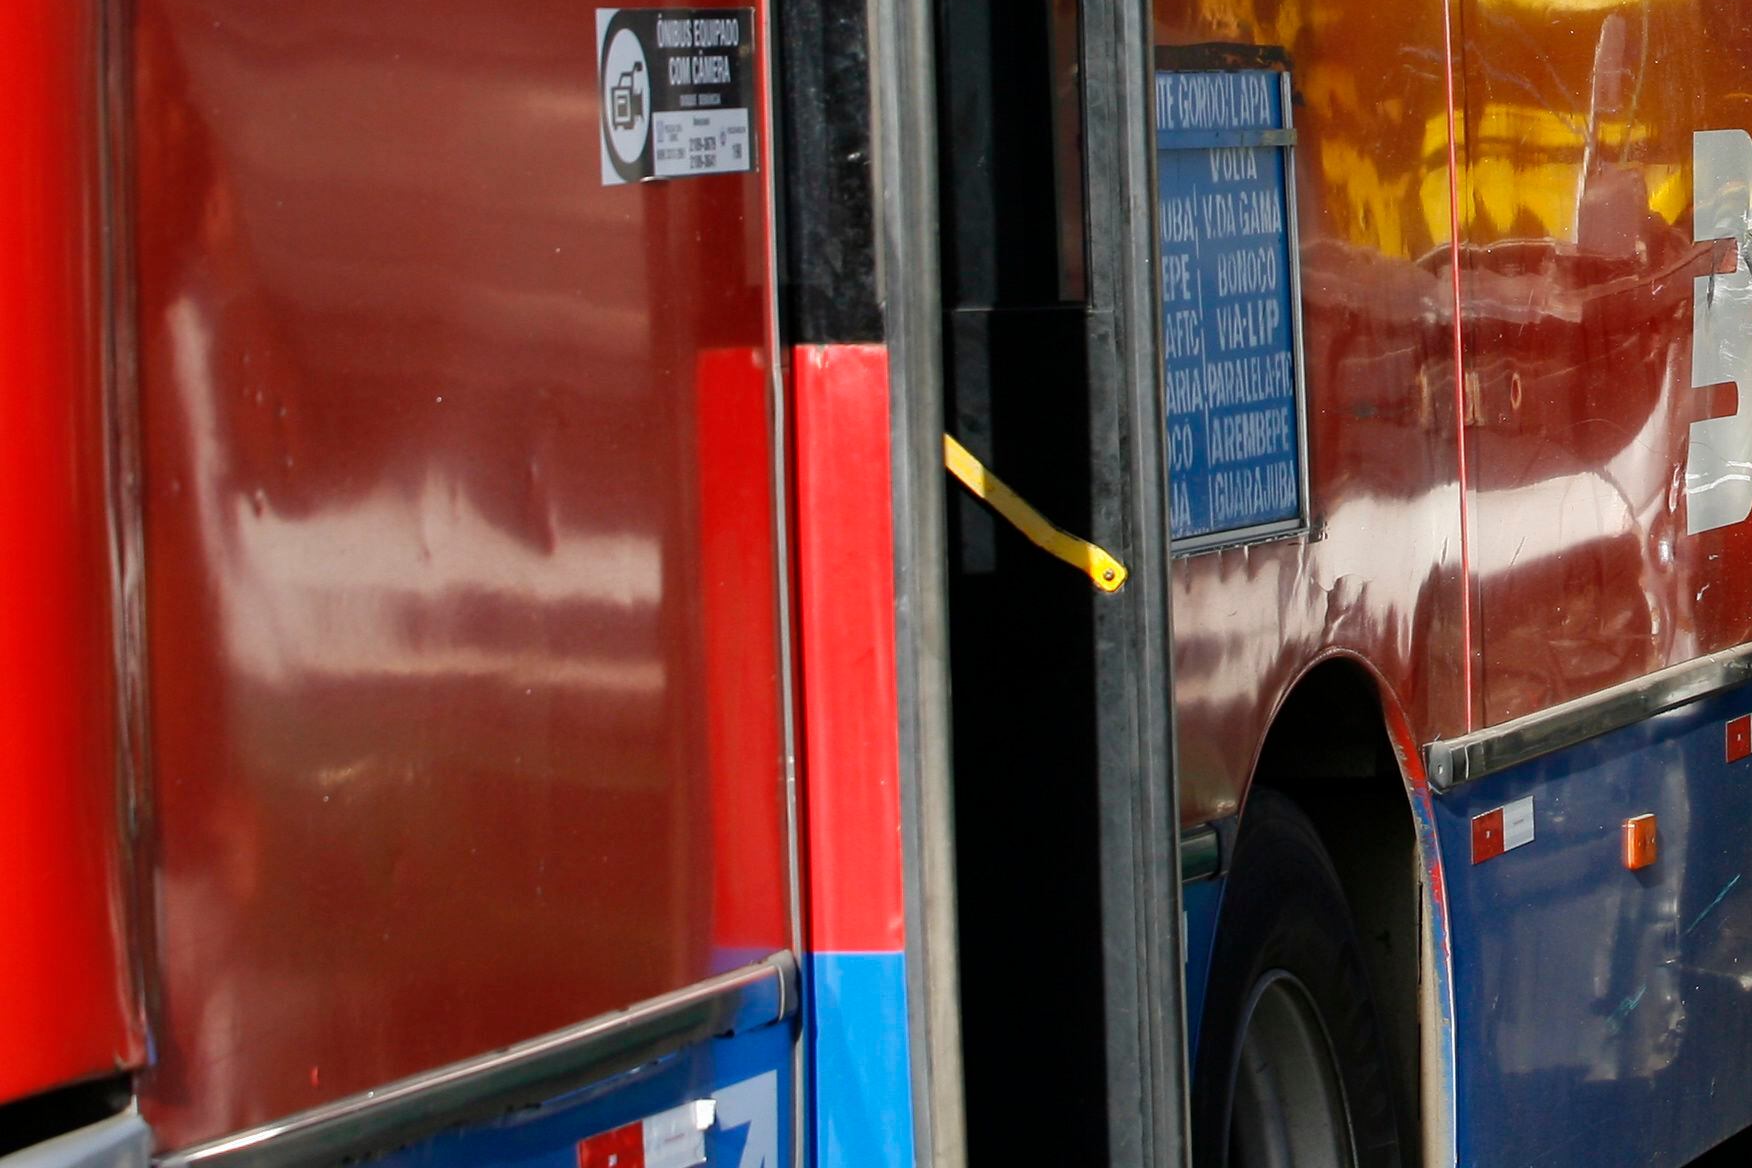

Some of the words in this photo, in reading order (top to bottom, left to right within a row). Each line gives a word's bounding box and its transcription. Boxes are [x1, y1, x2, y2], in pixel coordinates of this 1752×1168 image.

[656, 12, 693, 48] ÔNIBUS
[693, 18, 740, 48] EQUIPADO
[668, 56, 691, 86] COM
[691, 49, 731, 84] CÂMERA
[1210, 148, 1257, 183] VOLTA
[1160, 195, 1195, 243] UBA
[1239, 188, 1283, 234] GAMA
[1212, 407, 1289, 465] AREMBEPE
[1215, 460, 1298, 520] GUARAJUBA
